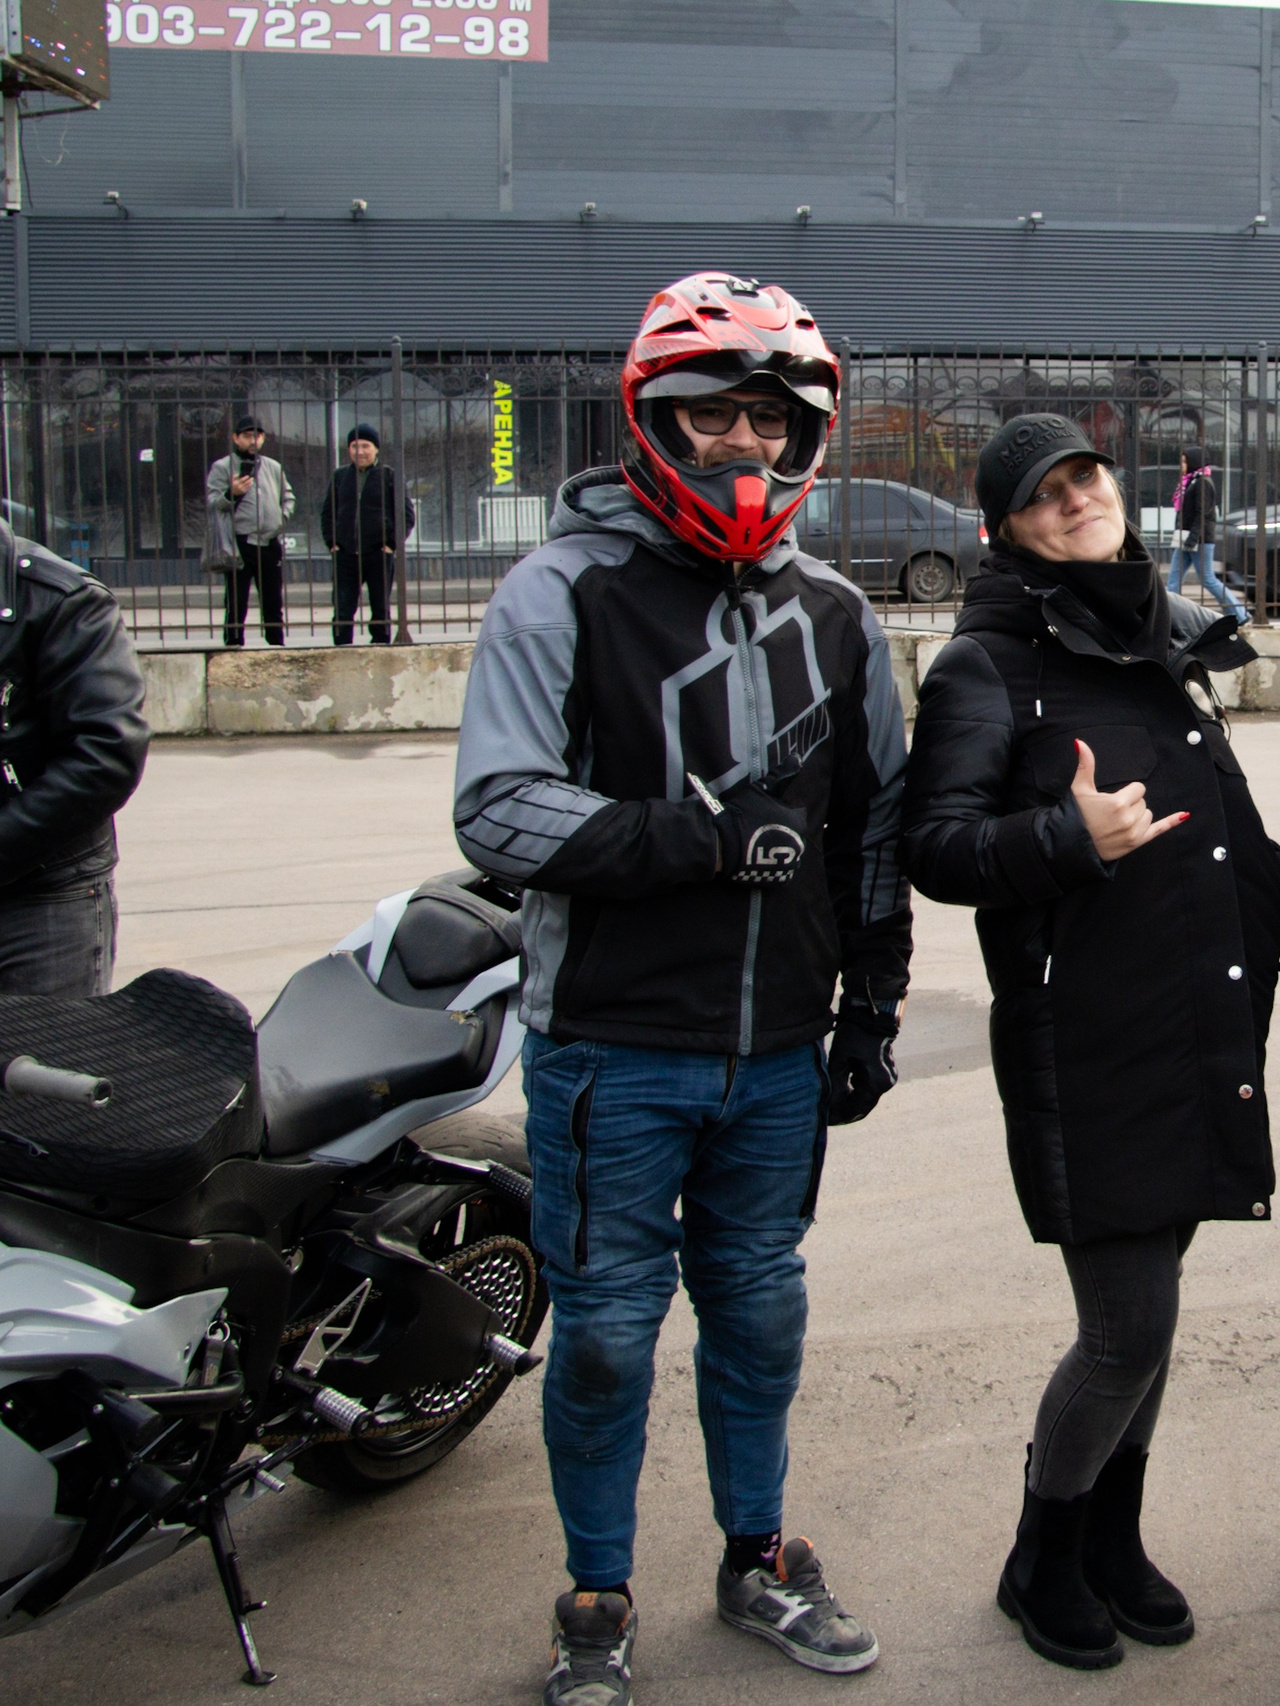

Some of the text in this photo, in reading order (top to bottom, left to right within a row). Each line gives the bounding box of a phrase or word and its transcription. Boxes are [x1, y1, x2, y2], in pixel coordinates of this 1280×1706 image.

[491, 380, 513, 485] АРЕНДА
[999, 417, 1066, 465] MOTO
[1006, 429, 1076, 475] PRAKTIKA
